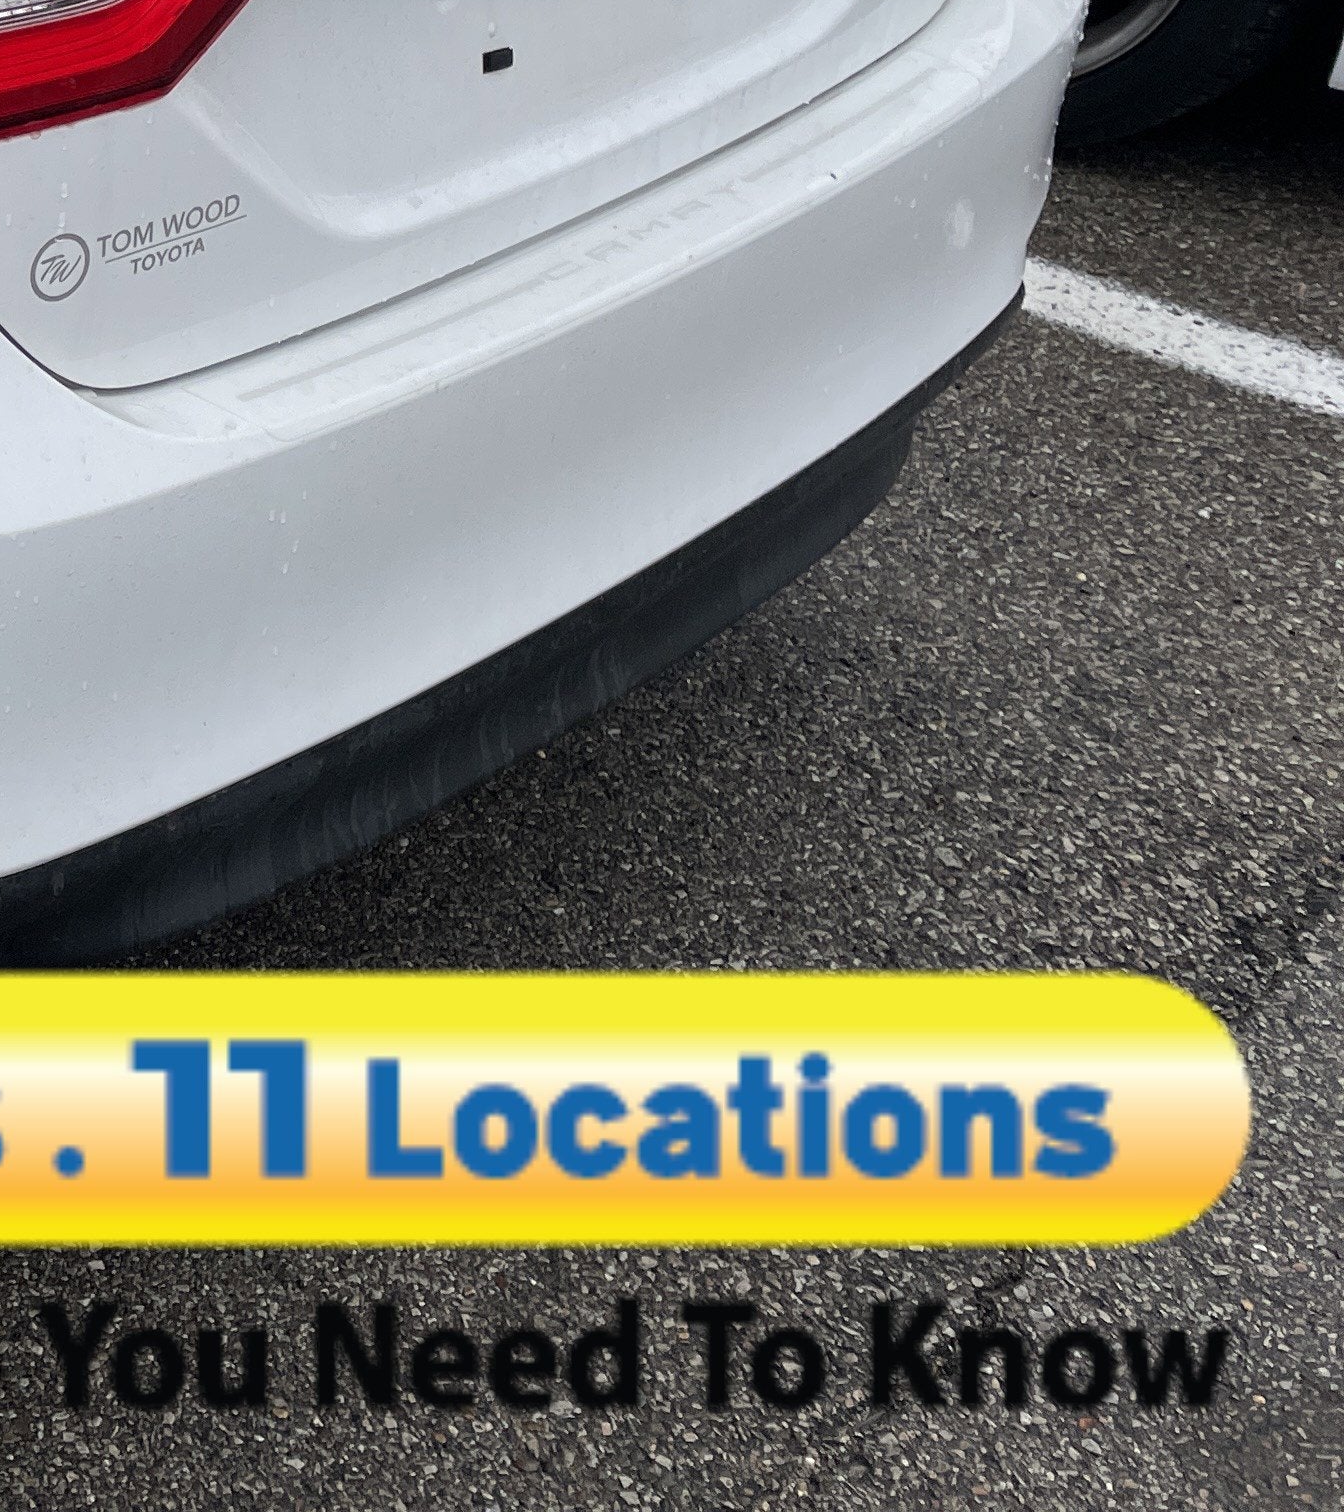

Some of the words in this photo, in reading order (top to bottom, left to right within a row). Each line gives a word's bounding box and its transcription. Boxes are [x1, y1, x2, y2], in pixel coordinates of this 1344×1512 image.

[96, 221, 154, 258] TOM
[162, 194, 241, 238] WOOD
[130, 237, 206, 275] TOYOTA
